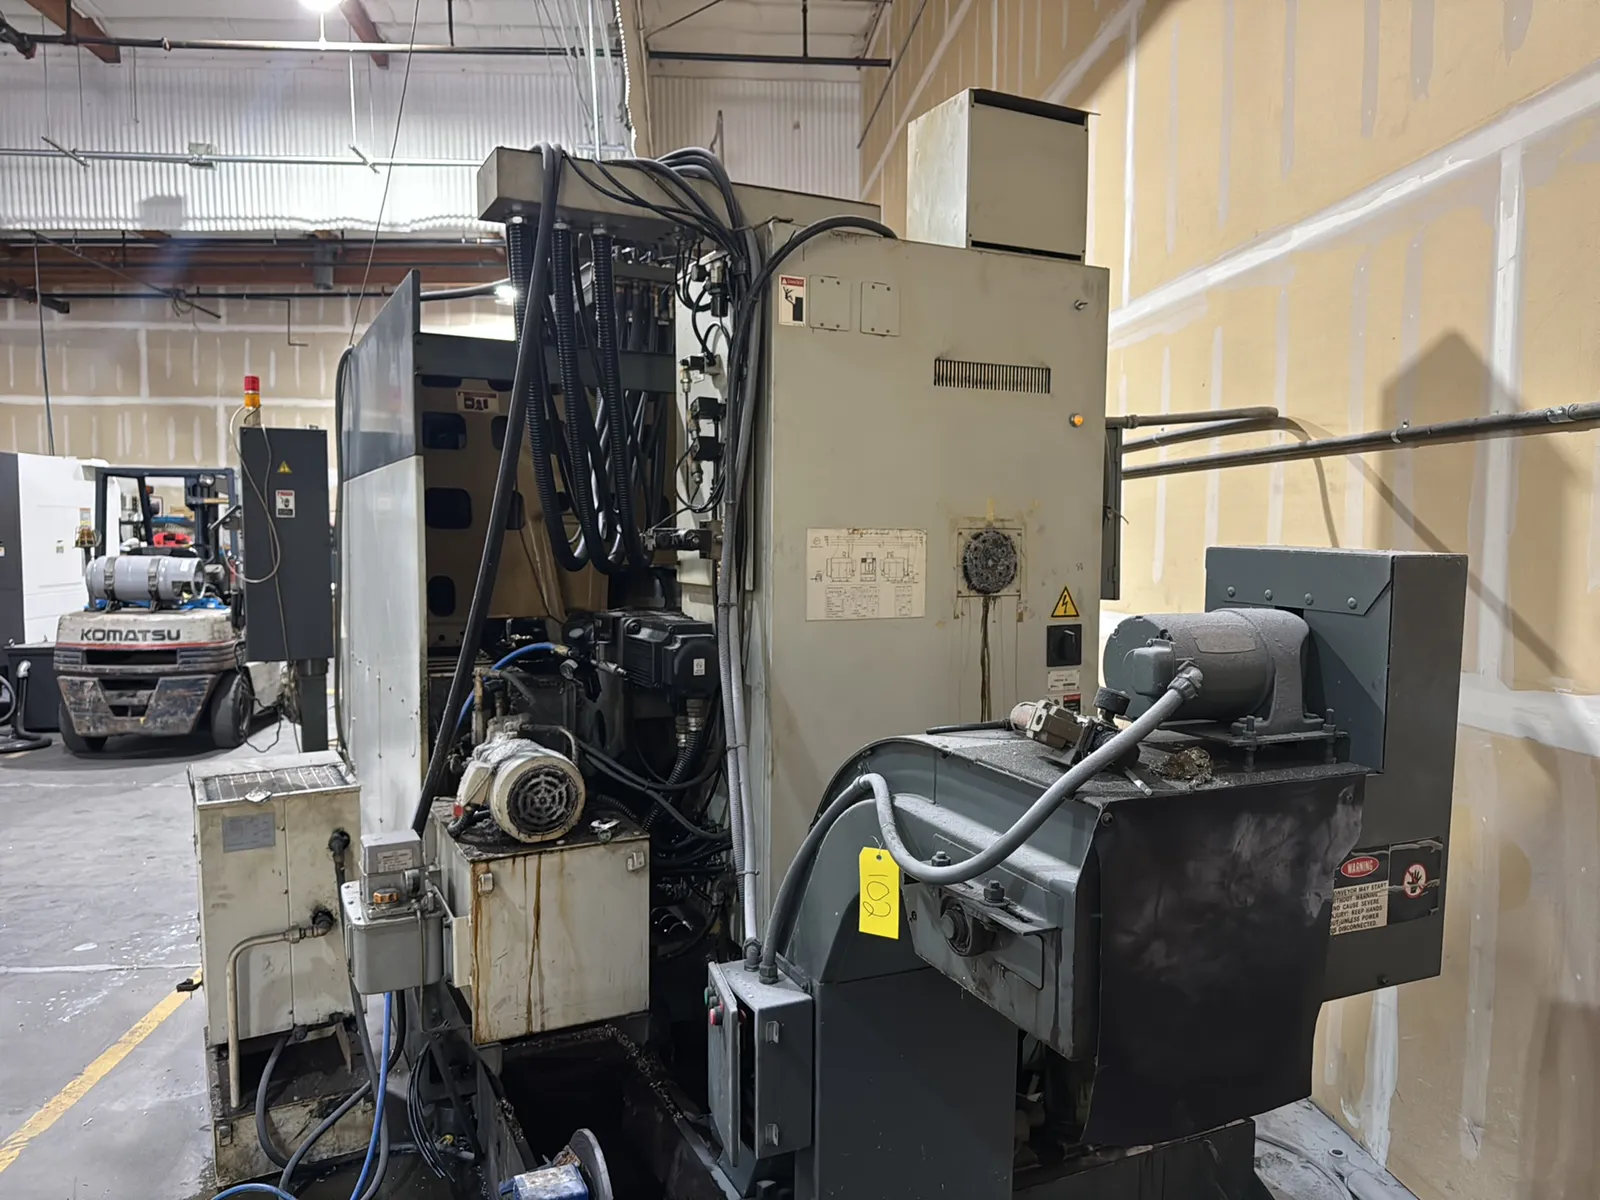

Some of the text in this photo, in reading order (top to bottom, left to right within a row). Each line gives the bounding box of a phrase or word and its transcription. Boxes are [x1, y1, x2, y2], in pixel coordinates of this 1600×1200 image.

[80, 628, 180, 642] KOMATSU
[1347, 860, 1373, 874] WARNING
[1334, 888, 1357, 897] ONVEYOR
